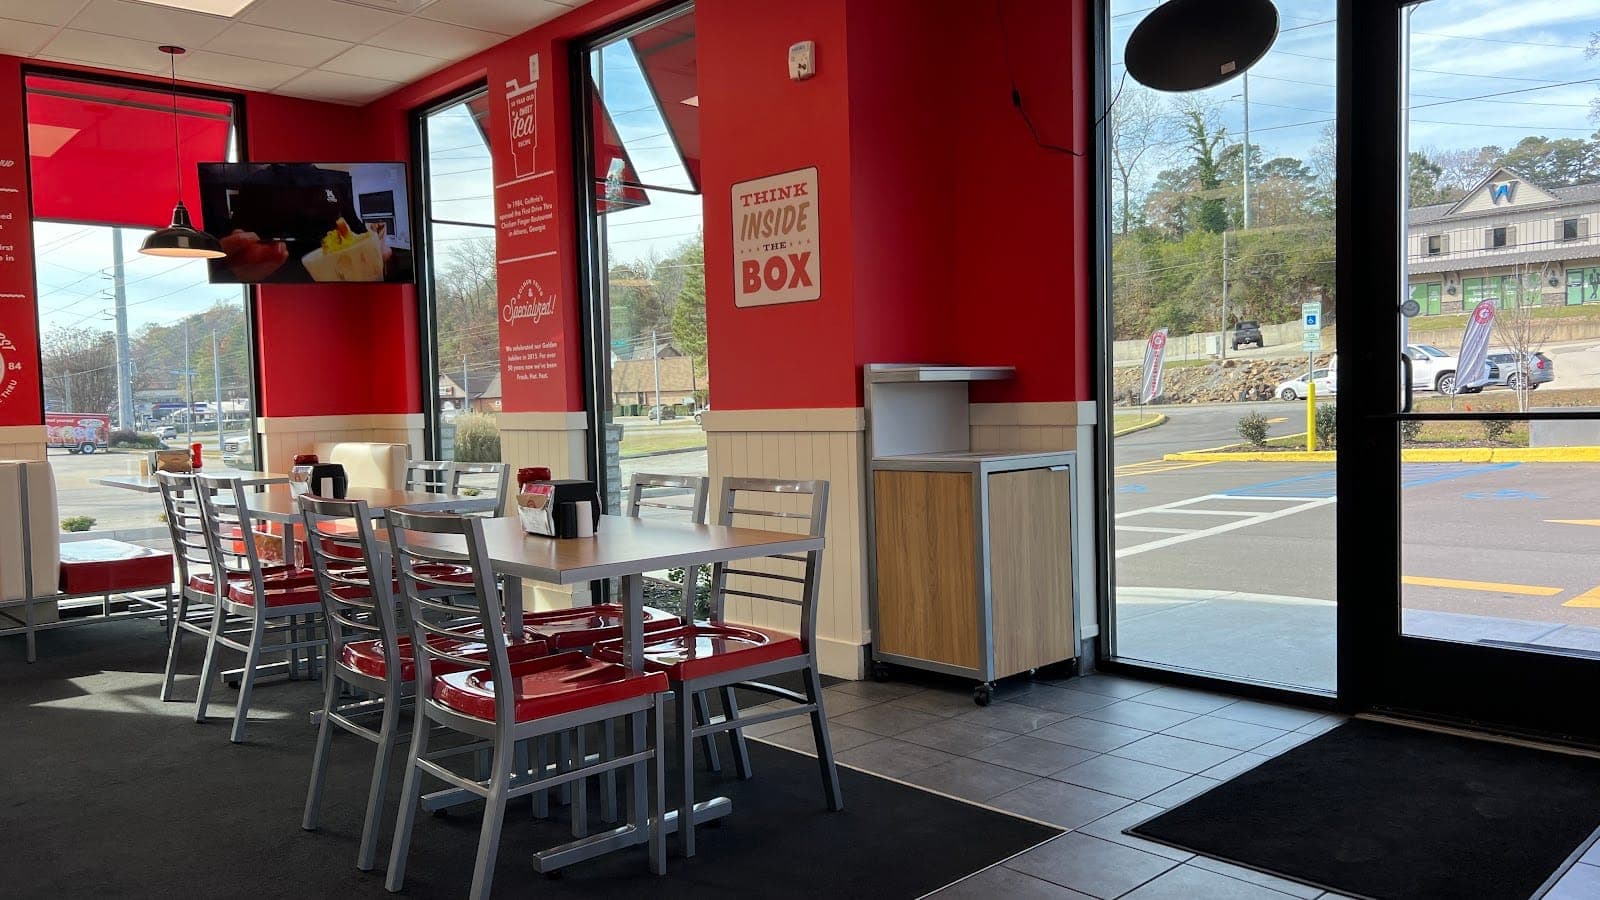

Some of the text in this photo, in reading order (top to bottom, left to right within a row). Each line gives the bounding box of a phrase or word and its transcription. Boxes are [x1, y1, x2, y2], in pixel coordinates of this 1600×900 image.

[516, 97, 525, 105] YEAR
[526, 94, 534, 102] OLD
[512, 111, 534, 139] tea
[525, 195, 543, 205] Guthrie's
[740, 182, 808, 207] THINK
[501, 221, 516, 229] Chicken
[531, 212, 552, 222] Restaurant
[740, 202, 810, 241] INSIDE
[763, 242, 786, 251] THE
[742, 252, 813, 294] BOX
[503, 294, 556, 326] Specialized!
[513, 344, 533, 352] celebrated
[8, 362, 21, 370] 84
[1, 380, 17, 398] THRU
